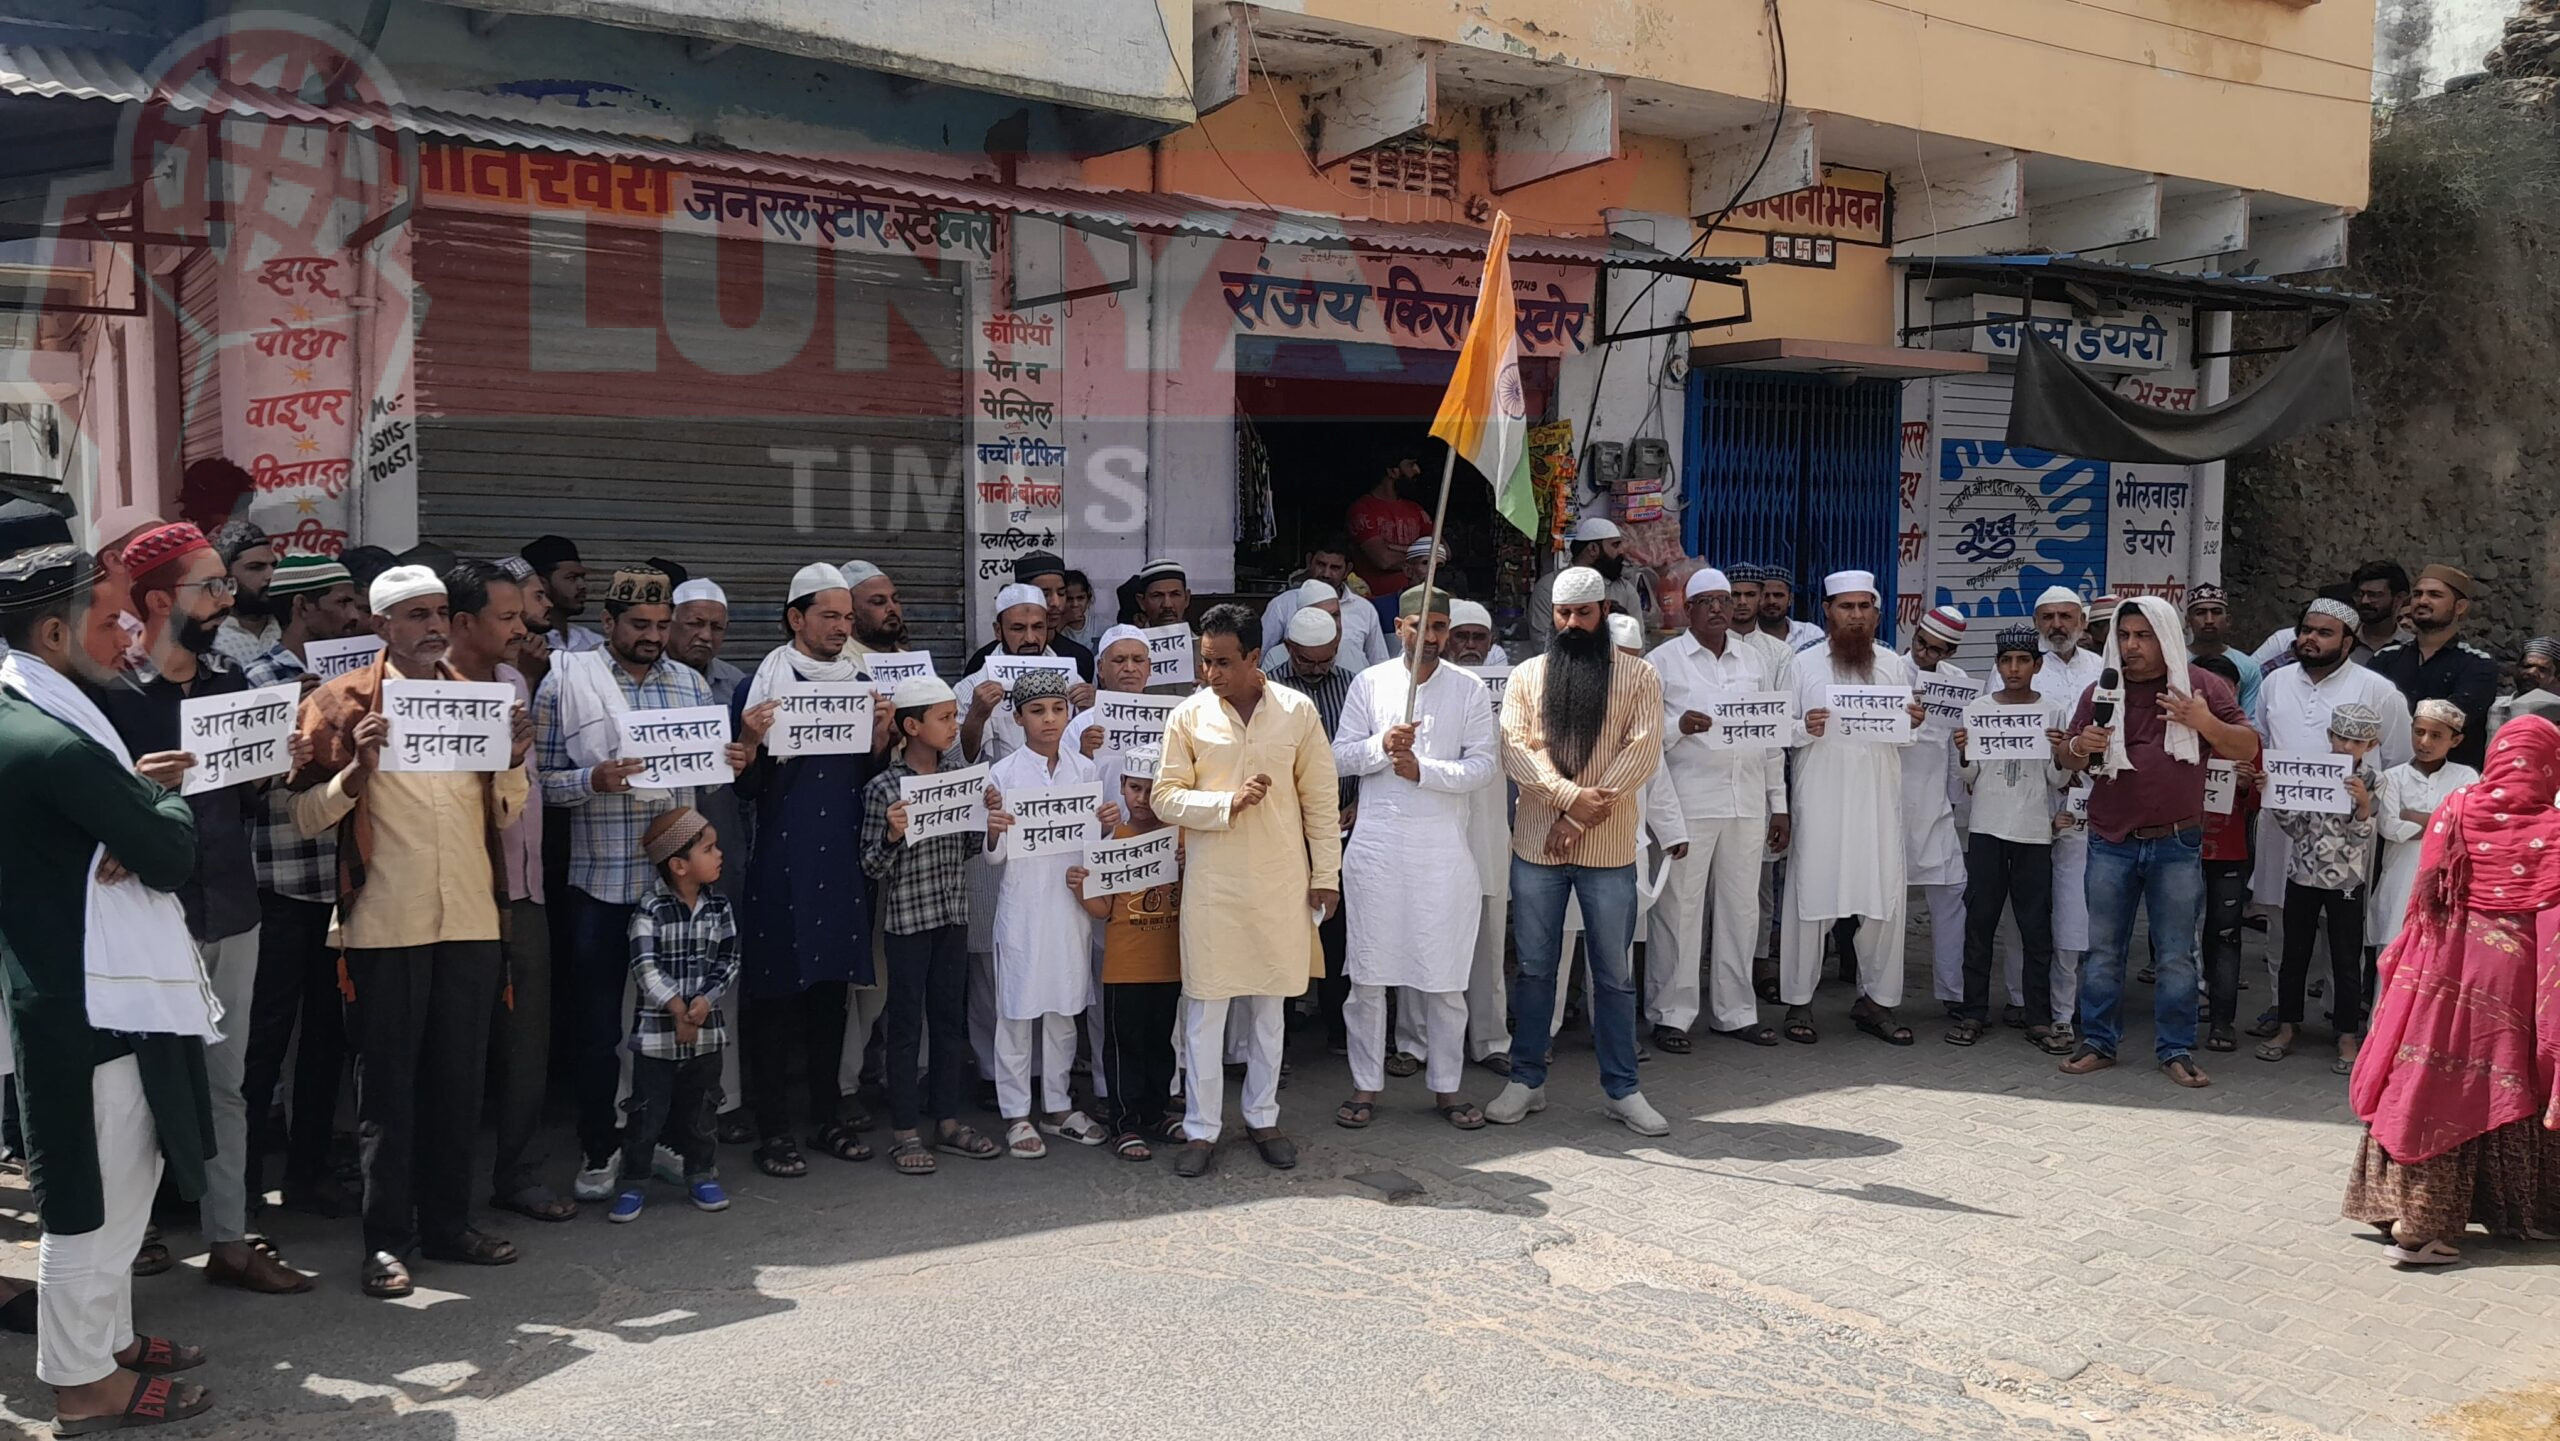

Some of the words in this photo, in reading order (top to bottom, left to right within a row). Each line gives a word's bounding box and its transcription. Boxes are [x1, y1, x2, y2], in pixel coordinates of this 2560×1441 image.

[684, 181, 810, 241] जनरल
[1219, 256, 1373, 331] संजय
[983, 351, 1022, 382] पेन
[1026, 362, 1048, 384] व
[246, 390, 351, 432] वाइपर
[979, 388, 1054, 430] पेन्सिल
[977, 436, 1015, 465] बच्चों
[1019, 436, 1066, 466] टिफिन
[1018, 476, 1062, 508] बोतल
[2115, 472, 2189, 515] भीलवाड़ा
[1010, 506, 1031, 523] एवं
[980, 527, 1041, 552] प्लास्टिक
[1041, 527, 1056, 548] के
[2123, 519, 2175, 557] डेयरी
[979, 559, 1000, 579] हर
[314, 646, 377, 676] आतंकवा
[393, 689, 505, 721] आतंकवाद
[781, 690, 867, 714] आतंकवाद
[1832, 689, 1905, 711] आतंकवाद
[1920, 680, 1978, 701] आतंकवाद
[191, 700, 291, 738] आतंकवाद
[1102, 699, 1170, 721] आतंकवा
[1713, 697, 1787, 718] आतंकवाद
[1970, 709, 2044, 730] आतंकवाद
[628, 716, 722, 744] आतंकवाद
[789, 722, 855, 750] मुर्दाबाद
[1722, 722, 1777, 744] मुर्दाबाद
[1980, 732, 2034, 755] मुर्दाबाद
[204, 737, 276, 782] मुर्दाबाद
[643, 746, 714, 782] मुर्दाबाद
[2266, 757, 2346, 780] आतंकवाद
[908, 777, 984, 806] आतंकवाद
[1013, 793, 1097, 818] आतंकवाद
[2274, 781, 2335, 804] मुर्दाबाद
[914, 804, 973, 835] मुर्दाबाद
[1023, 820, 1085, 851] मुर्दाबाद
[1090, 836, 1173, 865] आतंकवाद
[1100, 860, 1162, 889] मुर्दाबाद
